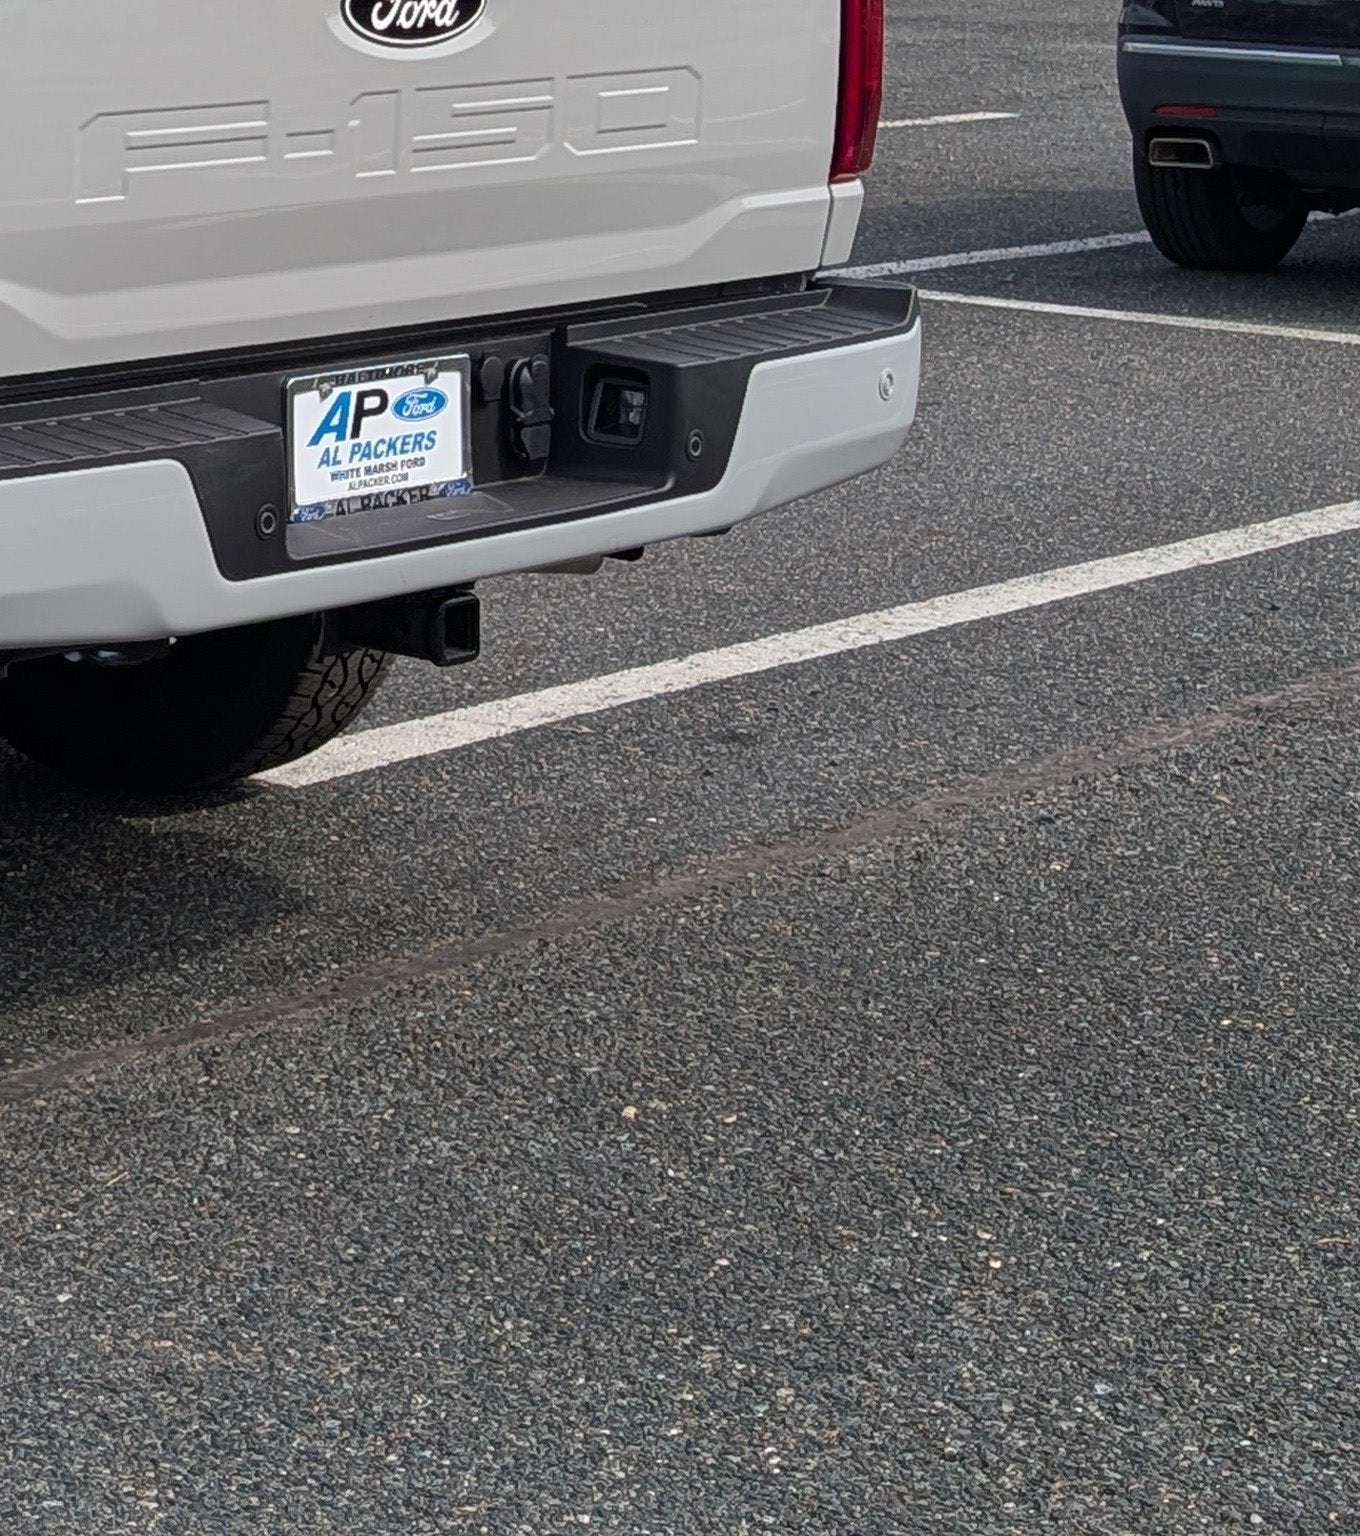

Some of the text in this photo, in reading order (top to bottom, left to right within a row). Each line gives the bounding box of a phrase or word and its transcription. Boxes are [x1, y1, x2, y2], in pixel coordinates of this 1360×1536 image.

[74, 64, 703, 204] F-150
[306, 388, 390, 447] AP
[316, 430, 437, 470] AL PACKERS
